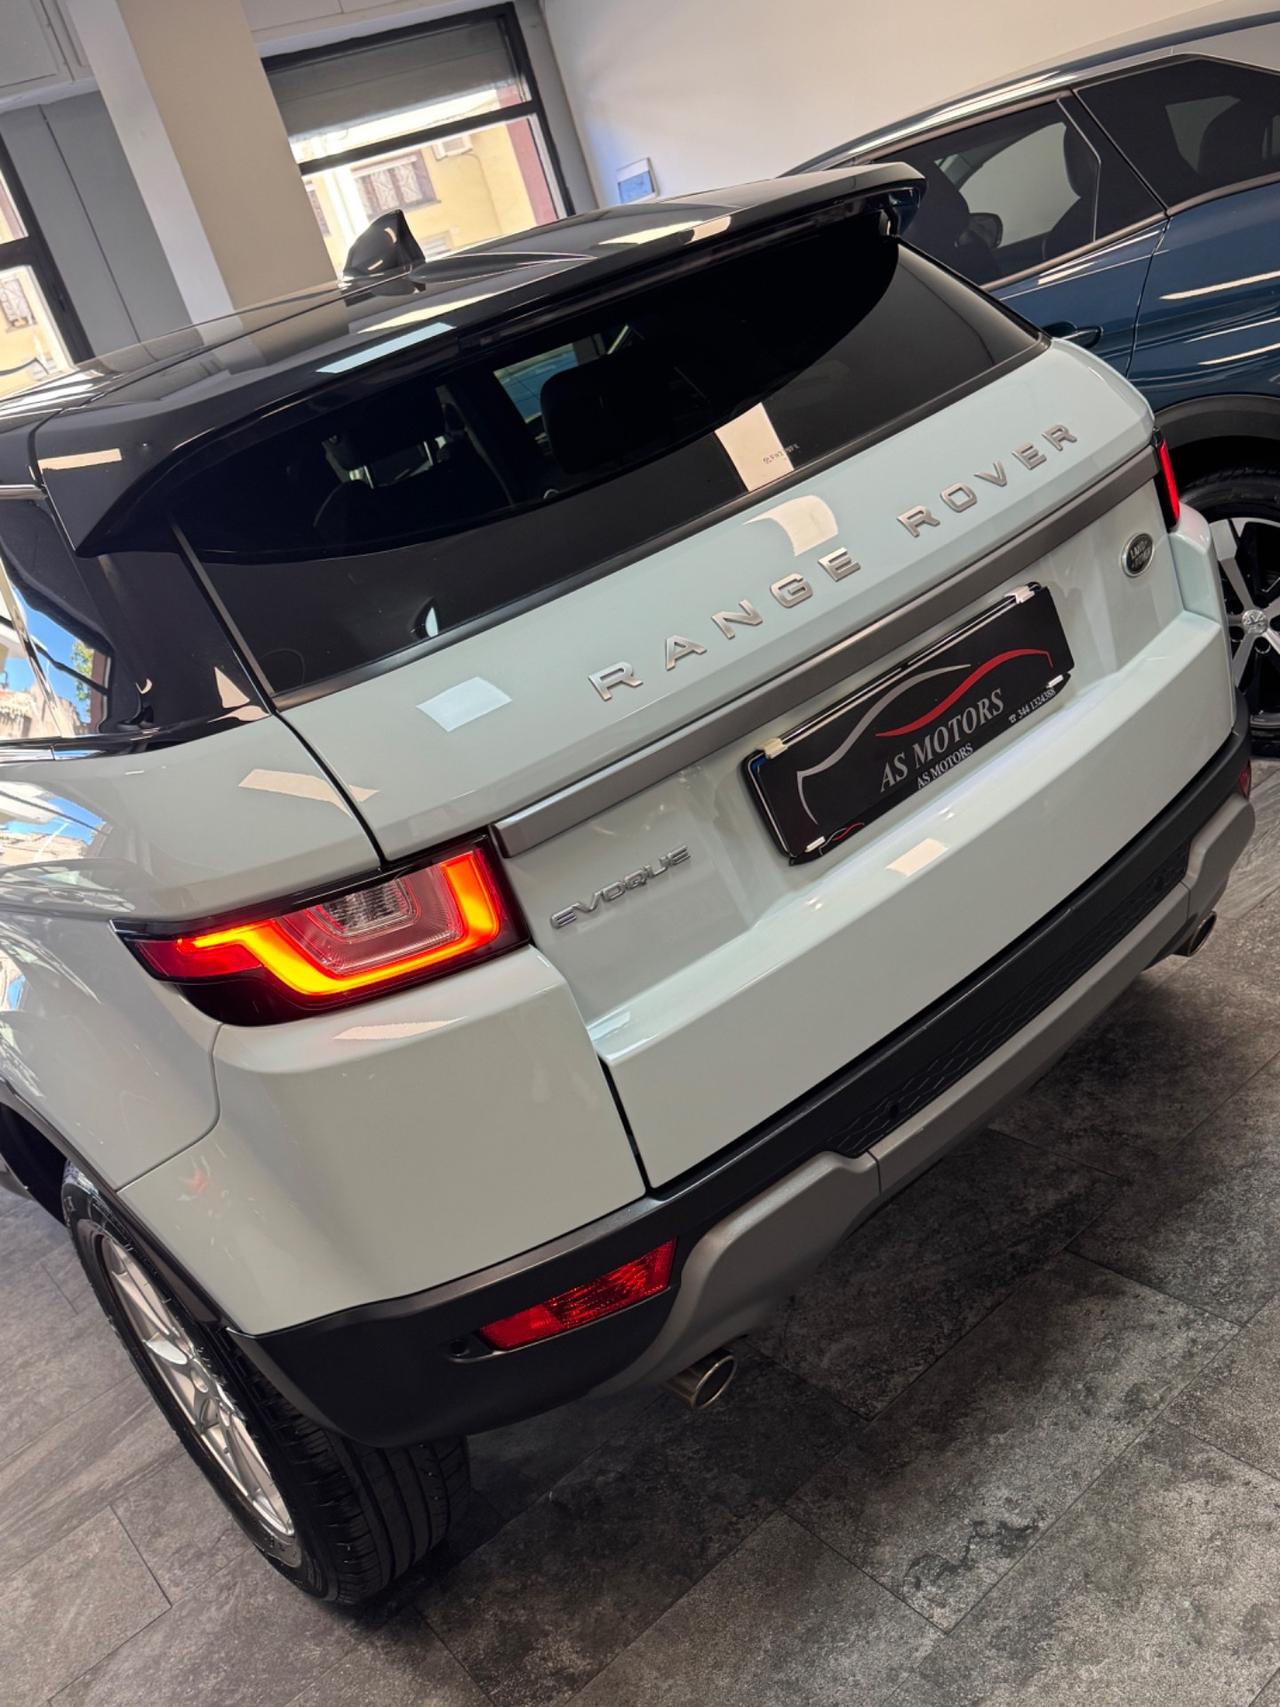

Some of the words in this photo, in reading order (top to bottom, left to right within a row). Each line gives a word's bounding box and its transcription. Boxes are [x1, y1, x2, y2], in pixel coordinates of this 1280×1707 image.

[588, 547, 861, 702] RANGE
[896, 425, 1077, 538] ROVER
[880, 752, 909, 793] AS
[912, 688, 1004, 769] MOTORS
[1017, 704, 1031, 719] 344
[916, 771, 931, 790] AS
[929, 742, 974, 779] MOTORS
[550, 845, 691, 929] EVOQUE
